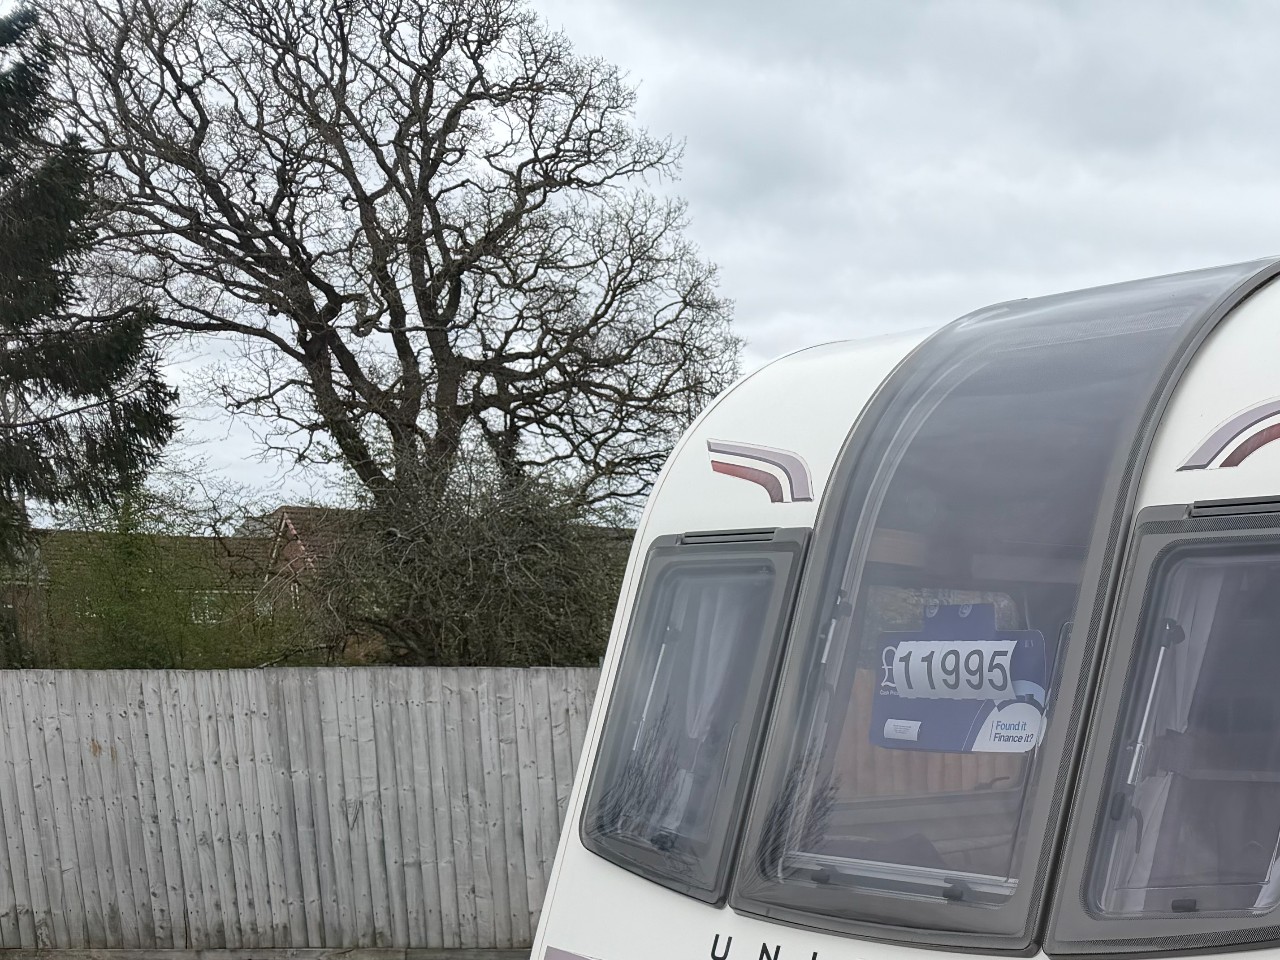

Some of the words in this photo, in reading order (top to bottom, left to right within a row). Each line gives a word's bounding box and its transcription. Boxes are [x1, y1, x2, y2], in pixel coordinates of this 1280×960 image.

[995, 720, 1021, 731] Found
[1021, 721, 1028, 731] it
[993, 732, 1023, 742] Finance
[1024, 733, 1034, 743] it?
